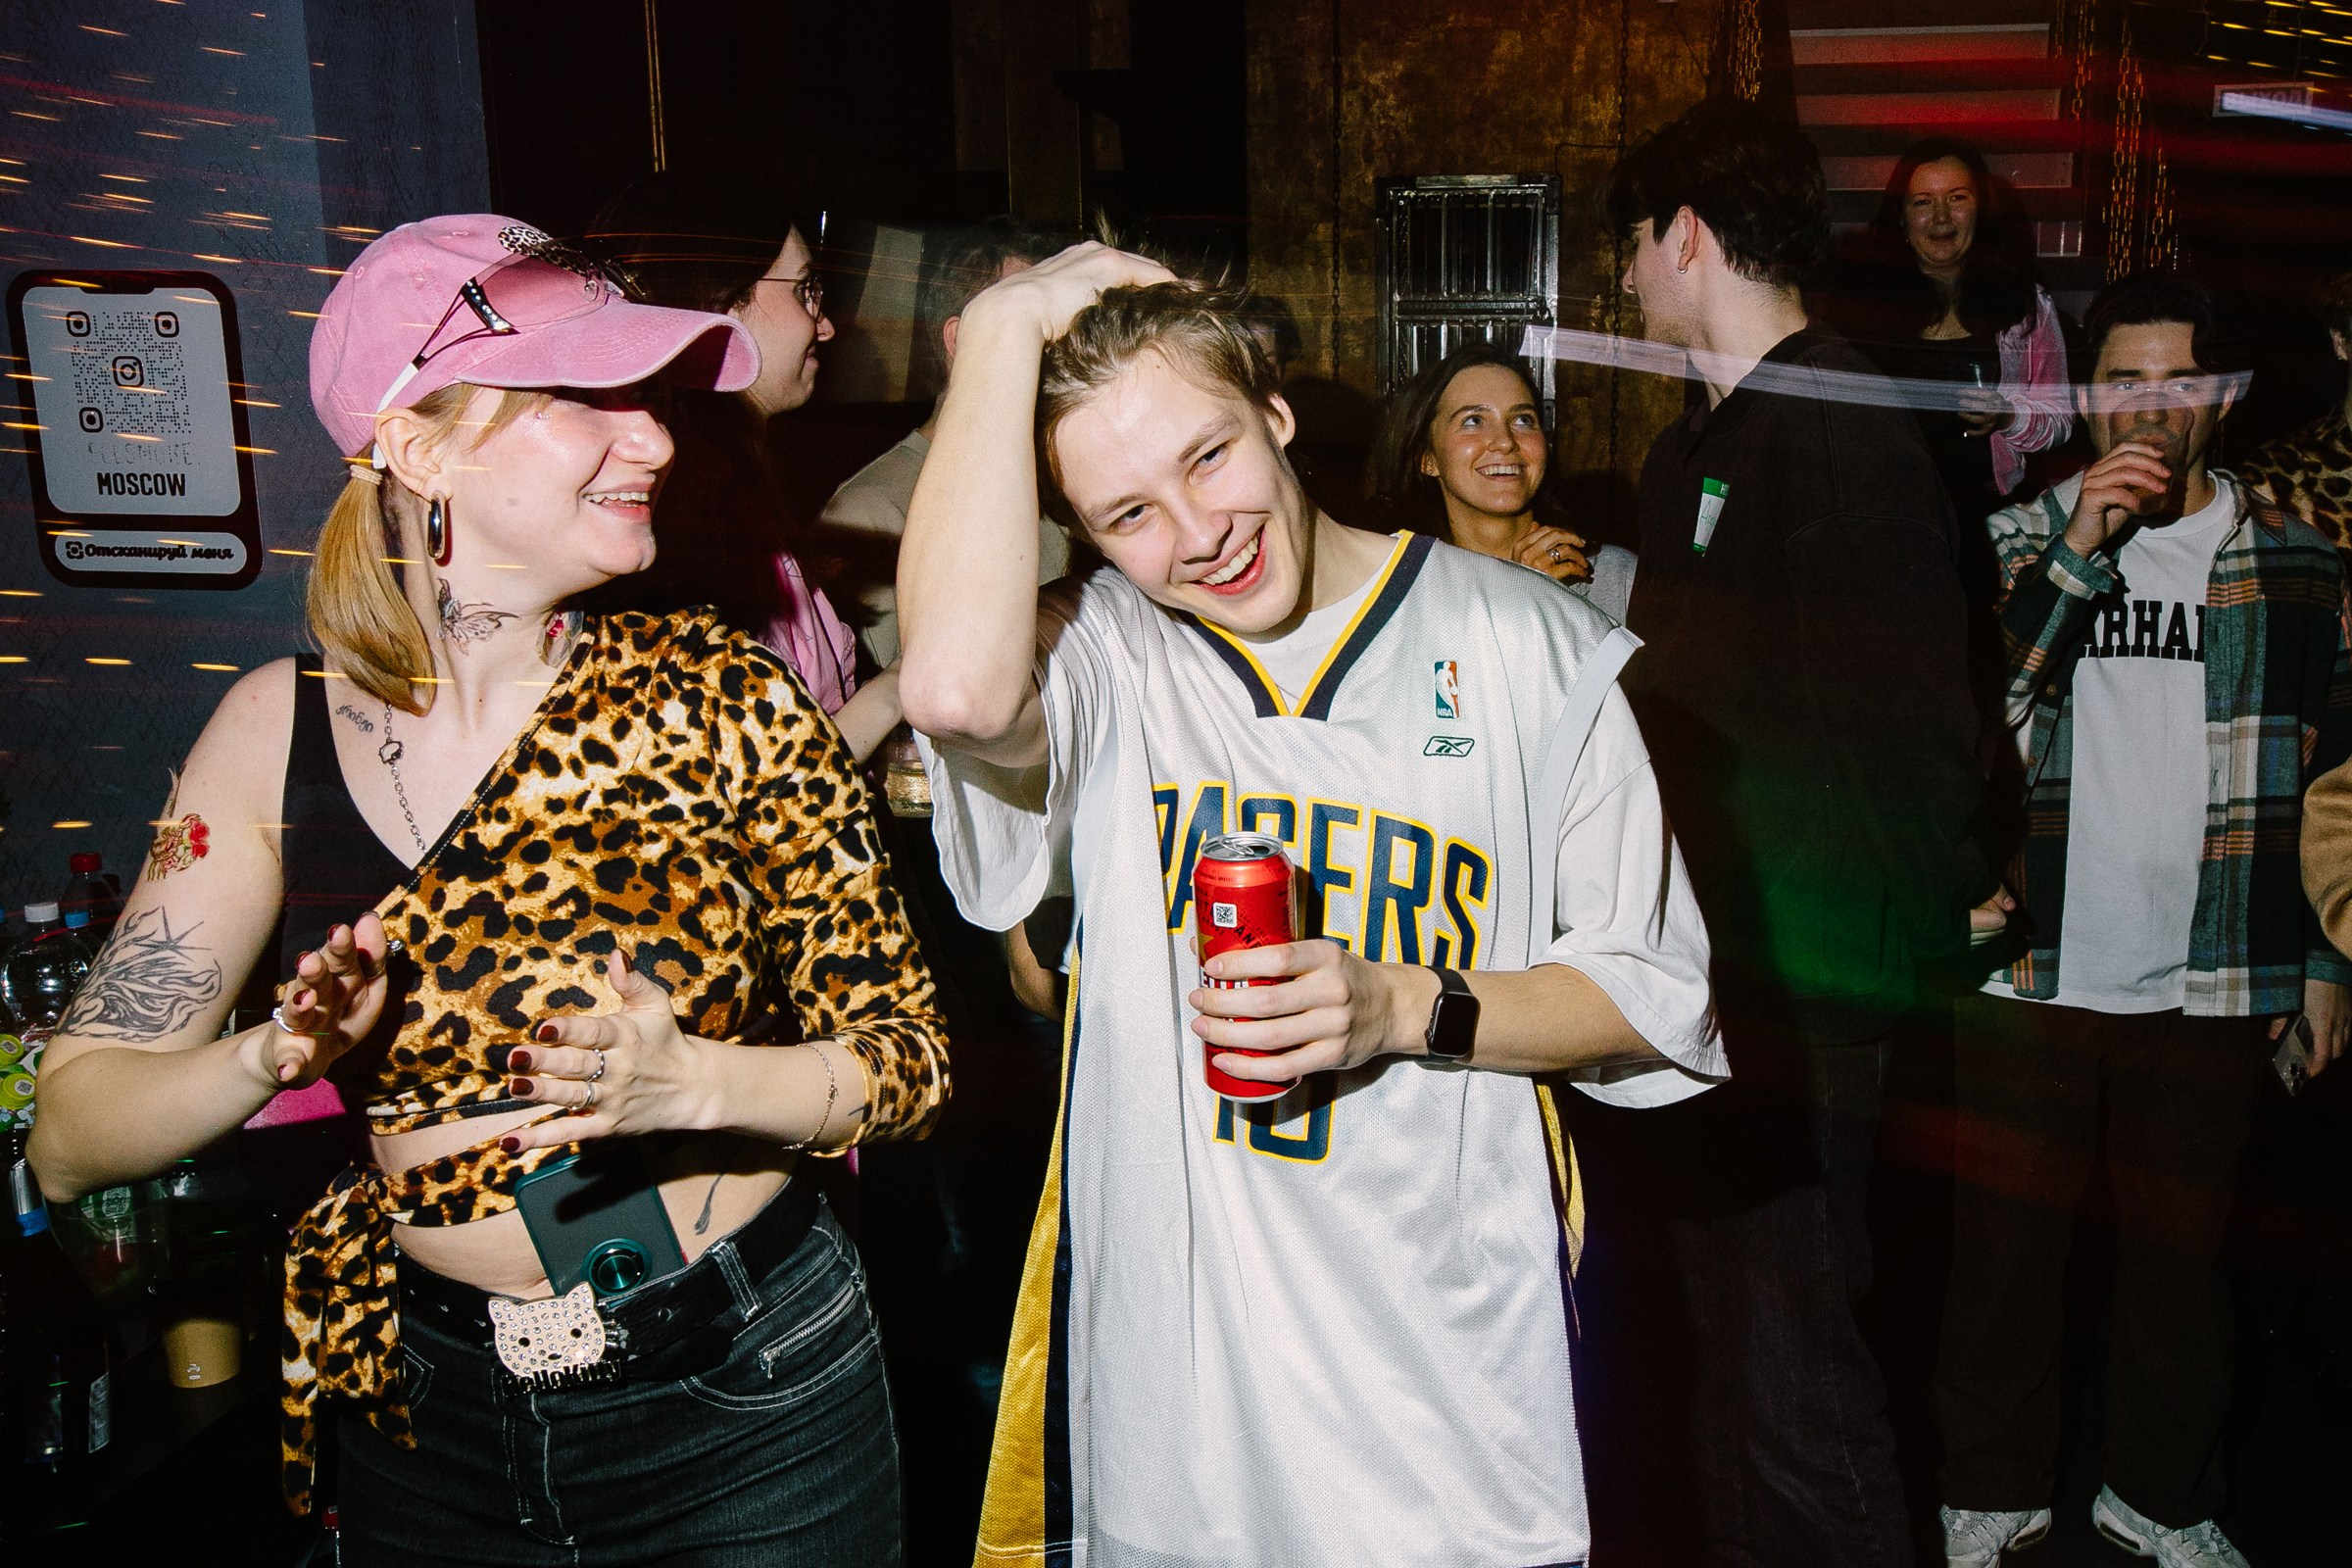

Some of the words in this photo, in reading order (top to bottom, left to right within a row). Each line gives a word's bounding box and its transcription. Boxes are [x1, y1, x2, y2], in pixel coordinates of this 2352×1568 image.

[96, 472, 186, 497] MOSCOW
[84, 543, 188, 562] Отсканируй
[190, 546, 234, 561] меня
[1437, 708, 1453, 716] NBA
